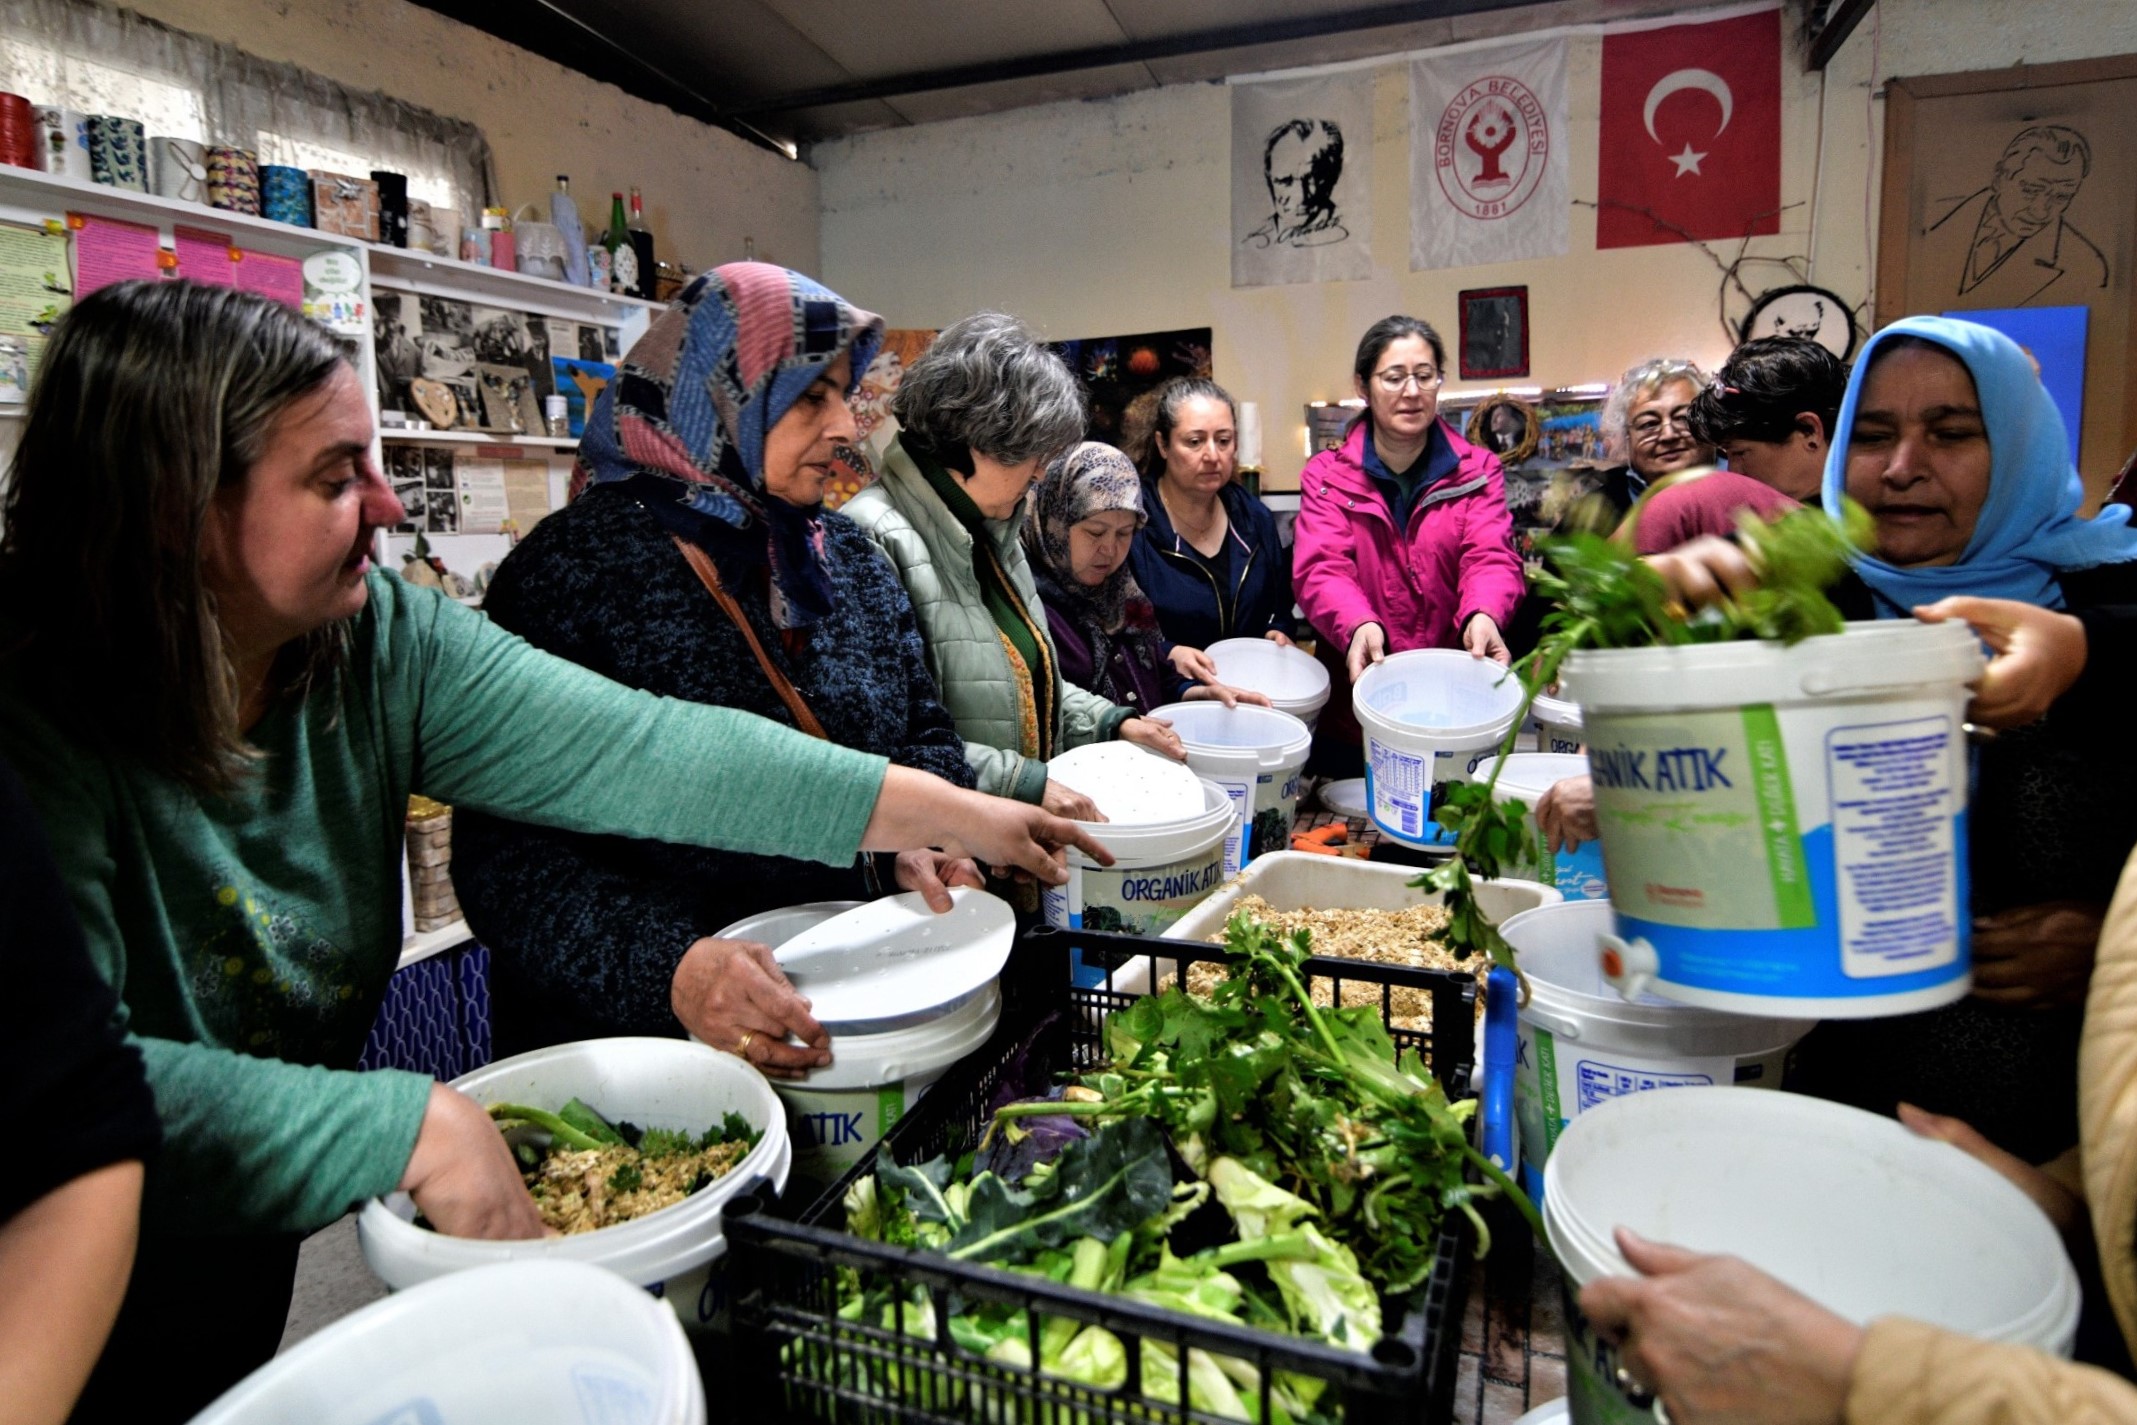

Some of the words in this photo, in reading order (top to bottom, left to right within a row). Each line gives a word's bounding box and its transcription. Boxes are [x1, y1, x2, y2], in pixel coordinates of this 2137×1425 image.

[1438, 88, 1482, 168] BORNOVA
[1475, 202, 1507, 216] 1881
[1655, 747, 1734, 792] ATIK
[1122, 869, 1200, 901] ORGANİK
